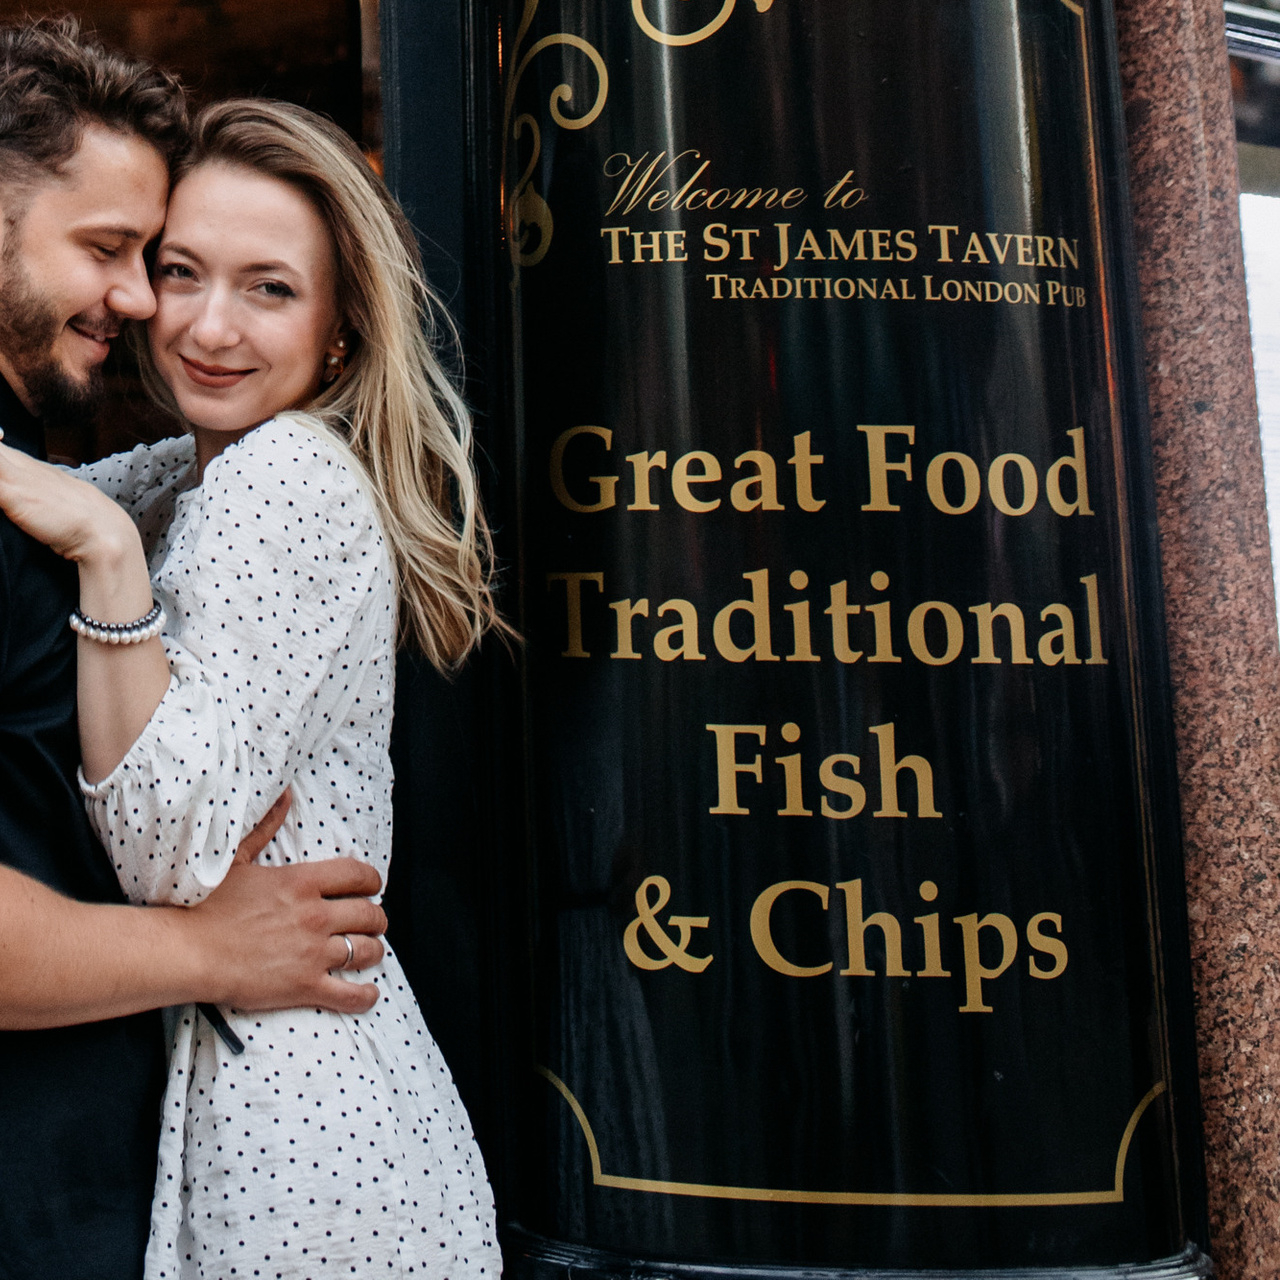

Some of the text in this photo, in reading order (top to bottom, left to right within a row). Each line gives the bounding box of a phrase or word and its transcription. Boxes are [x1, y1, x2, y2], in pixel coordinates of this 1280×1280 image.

[603, 149, 869, 217] Welcome to
[600, 222, 1080, 272] THE ST JAMES TAVERN
[705, 274, 1087, 308] TRADITIONAL LONDON PUB
[547, 423, 1095, 517] Great Food
[546, 568, 1109, 666] Traditional
[705, 721, 943, 819] Fish
[622, 874, 1069, 1013] & Chips
